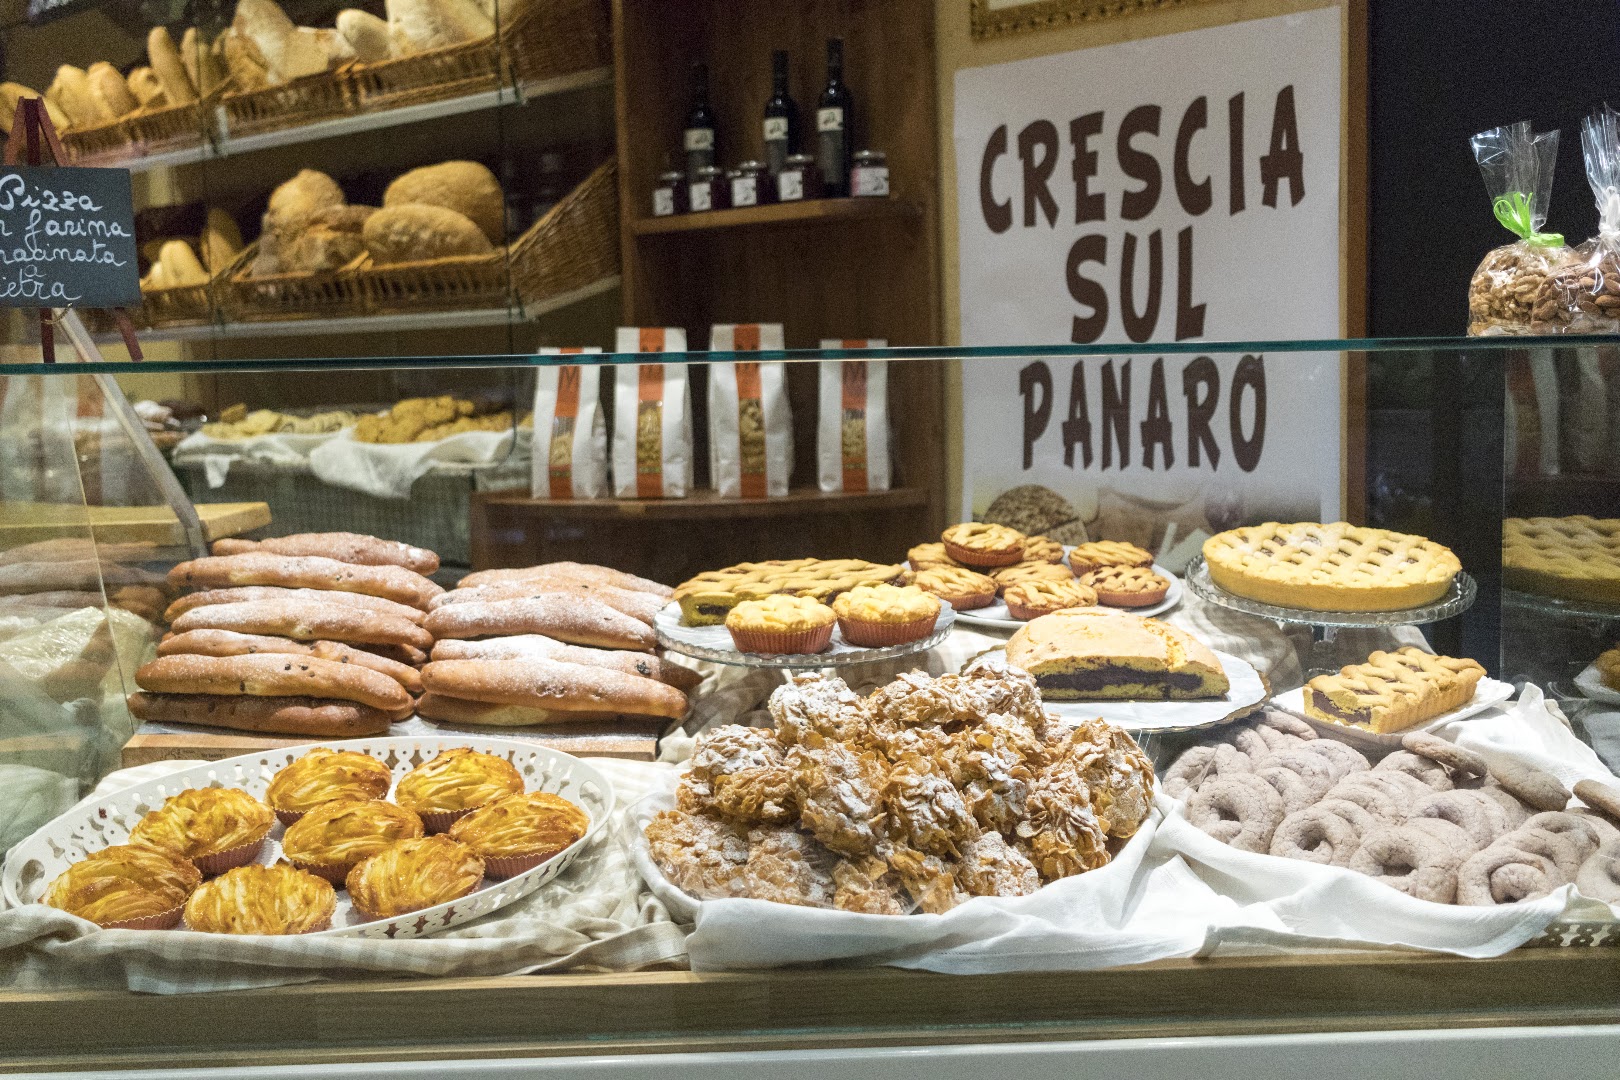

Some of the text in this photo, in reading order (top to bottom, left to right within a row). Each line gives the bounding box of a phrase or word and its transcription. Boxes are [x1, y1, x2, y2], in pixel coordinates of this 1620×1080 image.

[0, 173, 103, 211] Pizza
[980, 84, 1306, 235] CRESCIA
[24, 208, 132, 251] farina
[1065, 225, 1207, 344] SUL
[1018, 354, 1267, 473] PANARO
